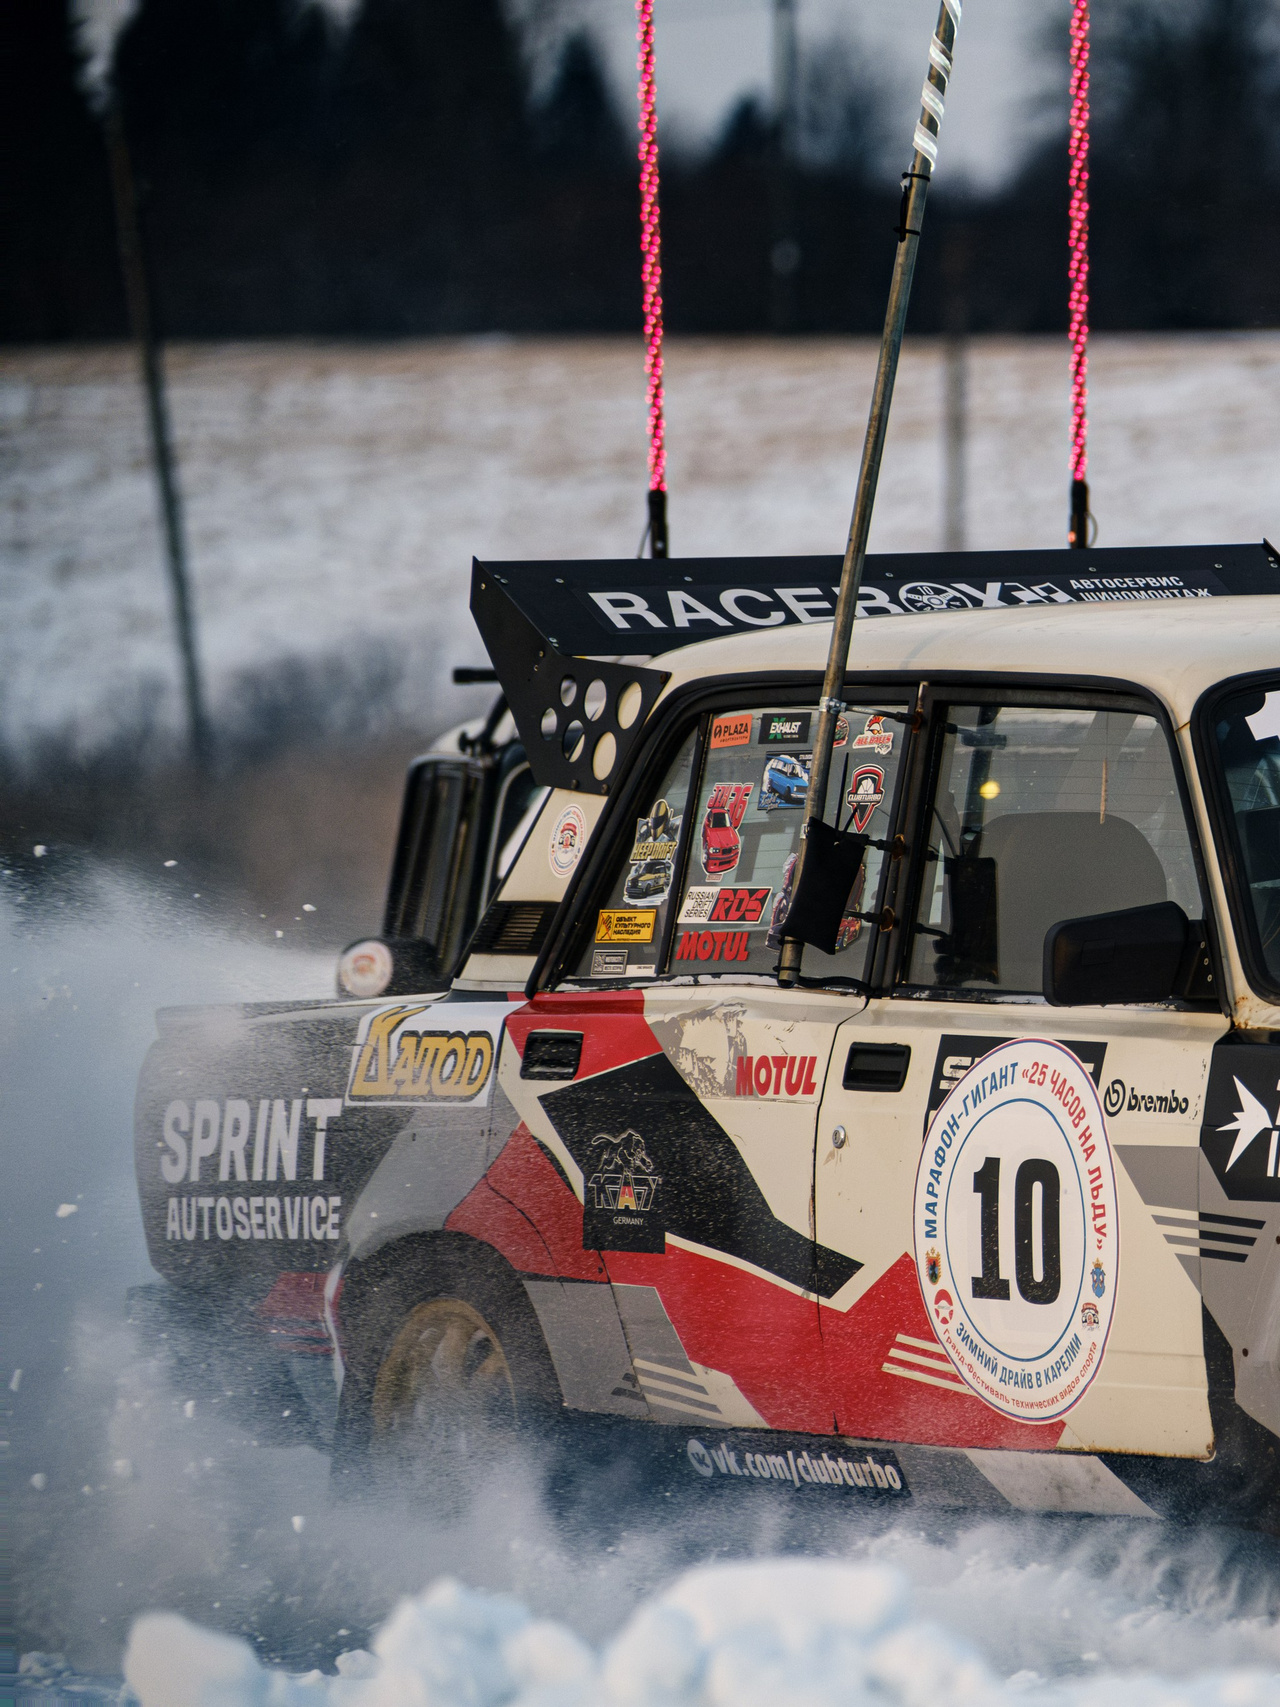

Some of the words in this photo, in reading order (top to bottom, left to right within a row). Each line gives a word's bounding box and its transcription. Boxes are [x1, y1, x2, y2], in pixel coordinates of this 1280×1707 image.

[1070, 576, 1184, 590] АВТОСЕРВИС
[1079, 588, 1213, 601] ШИНОМОНТАЖ
[722, 723, 749, 737] PLAZA
[769, 722, 802, 734] EXHAUST
[854, 736, 868, 746] ALL
[869, 734, 892, 745] BALLS
[684, 908, 709, 918] SERIES
[687, 891, 715, 900] RUSSIAN
[711, 889, 770, 921] RDS
[692, 900, 713, 909] DRIFT
[675, 930, 750, 962] MOTUL
[735, 1055, 817, 1096] MOTUL
[1126, 1087, 1190, 1115] brembo
[160, 1098, 343, 1184] SPRINT
[924, 1061, 1019, 1239] МАРАФОН-ГИГАНТ
[1050, 1069, 1087, 1129] ЧАСОВ
[1077, 1125, 1097, 1162] НА
[165, 1196, 342, 1241] AUTOSERVICE
[613, 1216, 644, 1226] GERMANY
[971, 1156, 1061, 1306] 10
[956, 1322, 998, 1378] ЗИМНИЙ
[999, 1366, 1034, 1390] ДРАЙВ
[1035, 1374, 1043, 1389] В
[1044, 1332, 1083, 1386] КАРЕЛИИ
[1010, 1394, 1060, 1410] технических
[1059, 1377, 1081, 1400] видов
[1079, 1341, 1098, 1378] спорта
[710, 1443, 902, 1490] vk.com/clubturbo
